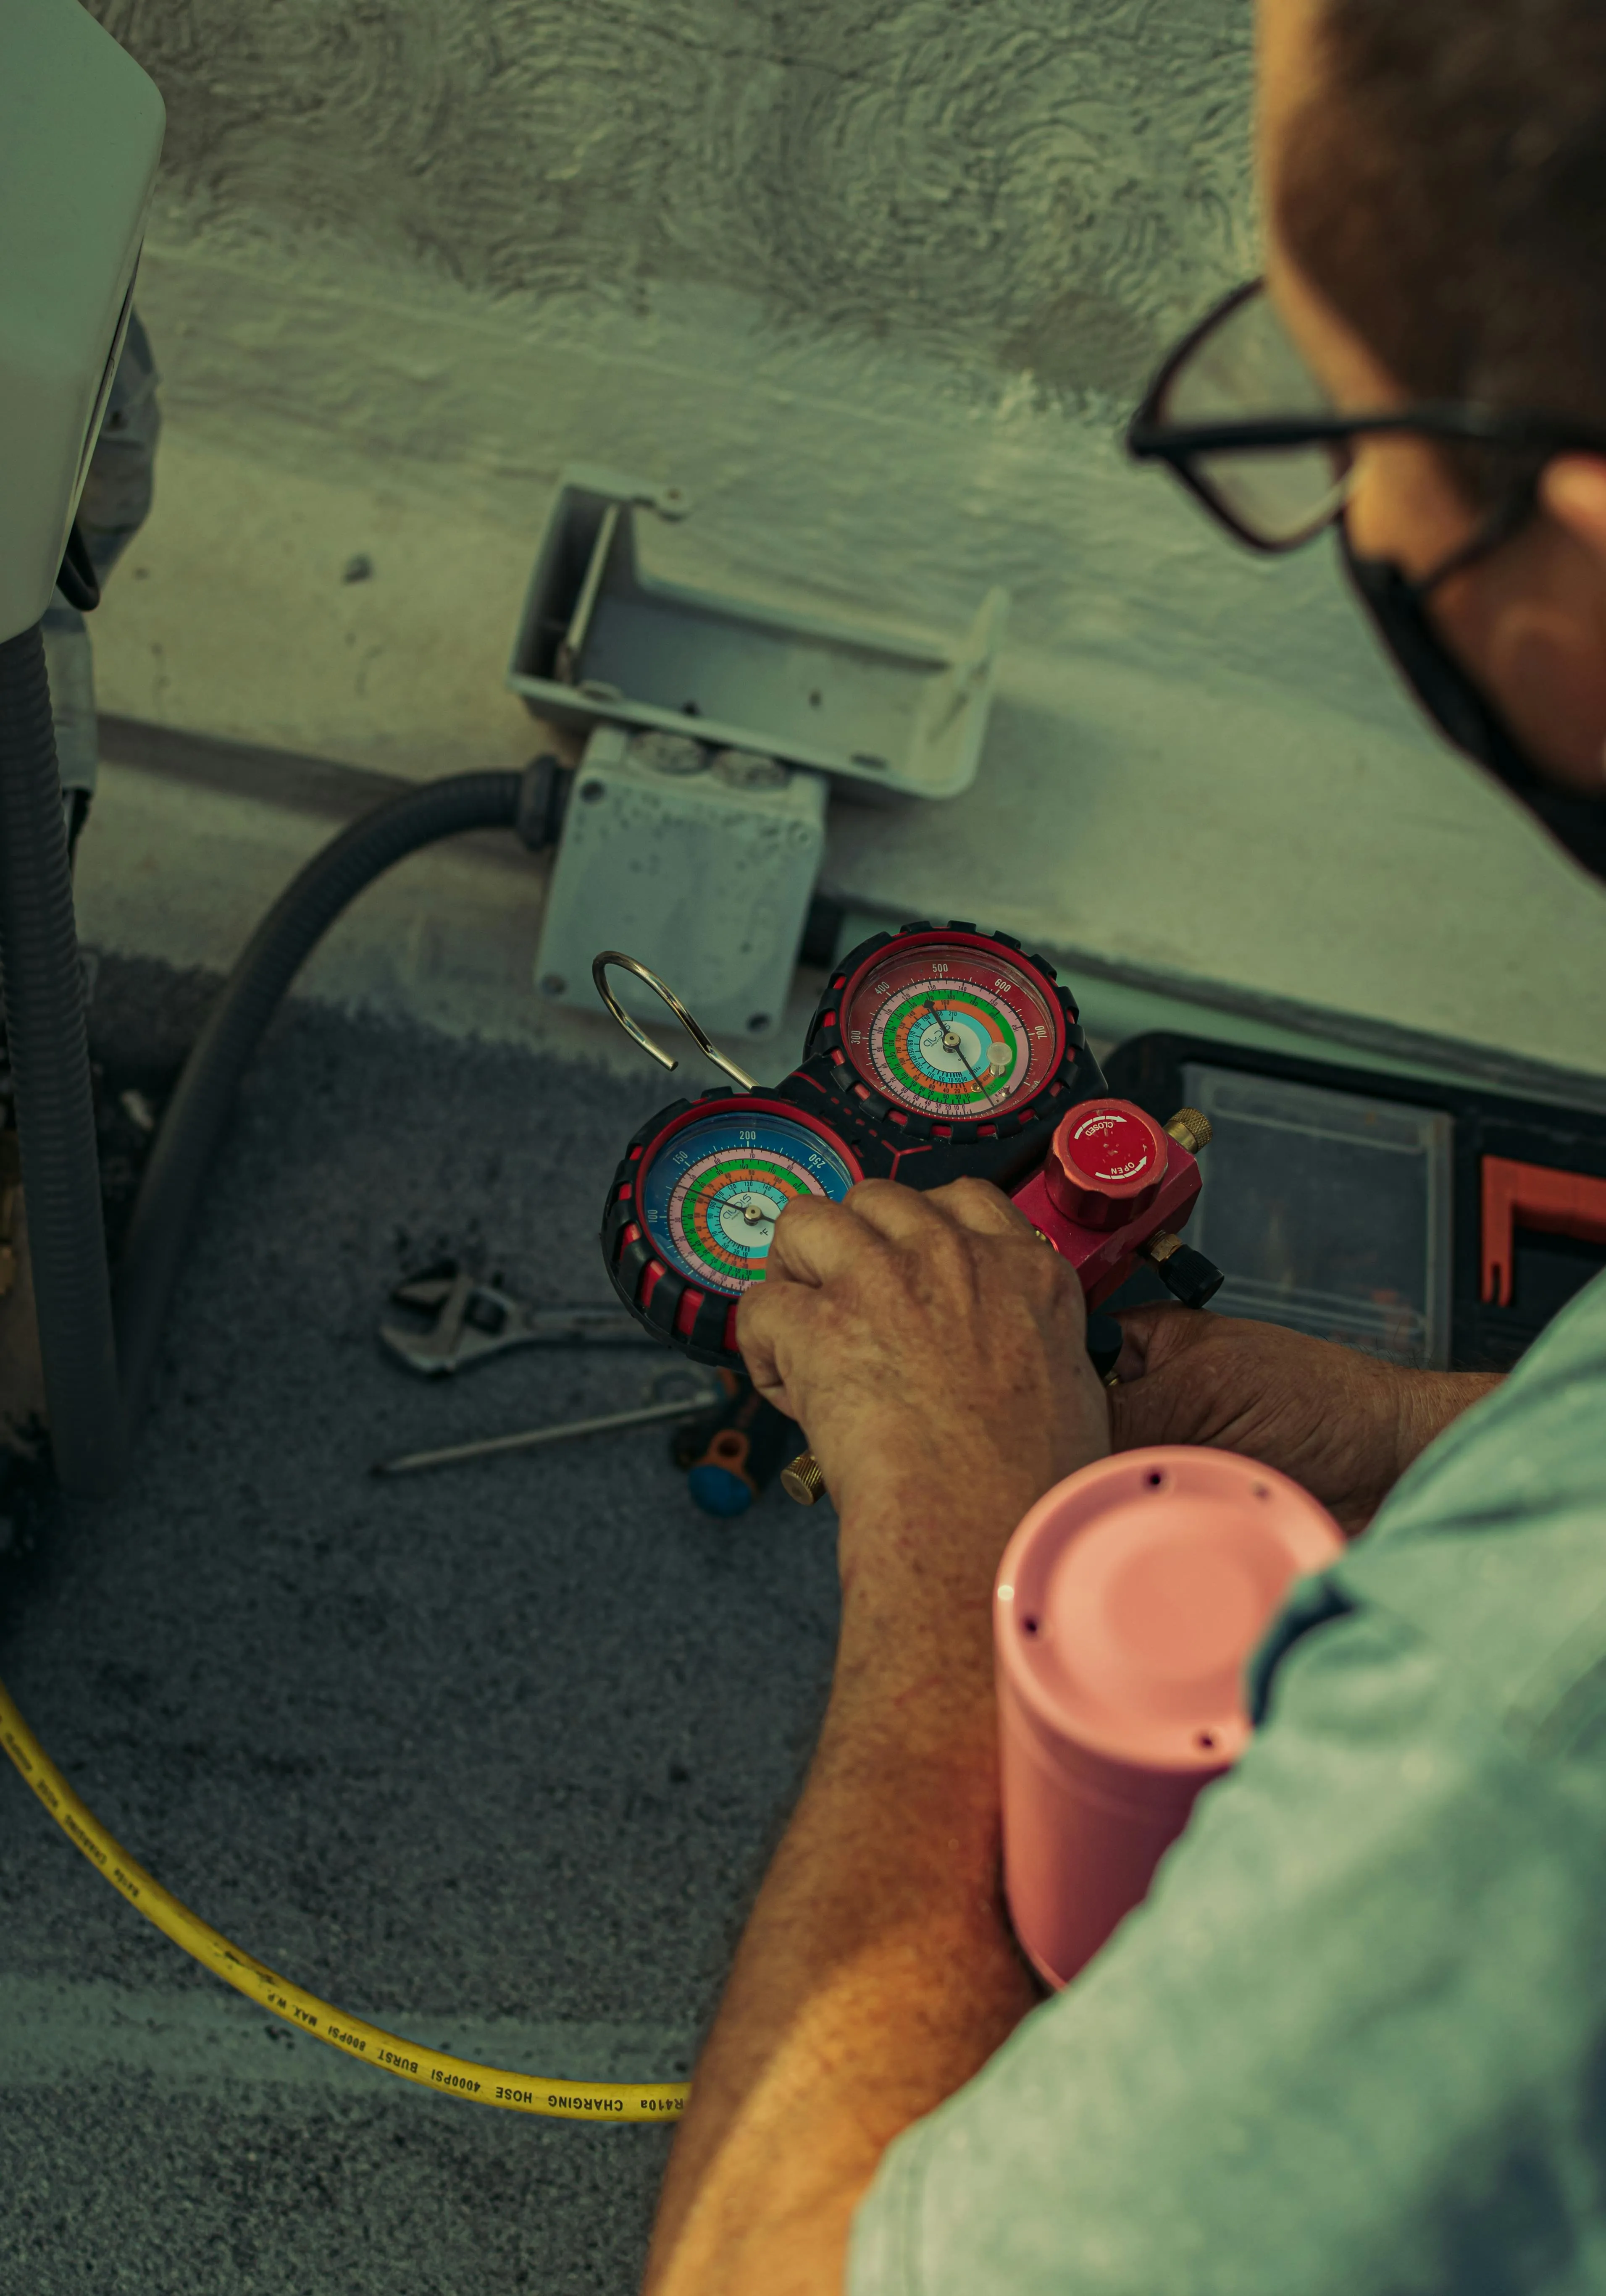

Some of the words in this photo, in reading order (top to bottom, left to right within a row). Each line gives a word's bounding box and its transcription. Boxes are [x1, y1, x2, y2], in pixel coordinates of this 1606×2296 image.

[851, 1030, 861, 1044] 300
[875, 981, 890, 994] 400
[995, 979, 1011, 992] 600
[1035, 1026, 1047, 1039] 700
[1085, 1121, 1113, 1136] CLOSED
[648, 1210, 658, 1223] 100
[673, 1151, 688, 1164] 150
[740, 1131, 756, 1140] 200
[809, 1154, 825, 1168] 250
[1111, 1162, 1135, 1174] OPEN
[793, 1183, 802, 1191] 120
[328, 2026, 366, 2051] 800PSI
[378, 2048, 419, 2073] BURST
[431, 2068, 481, 2093] 4000PSI
[495, 2086, 533, 2104] HOSE
[548, 2095, 623, 2112] CHARGING
[640, 2098, 684, 2111] R410a
